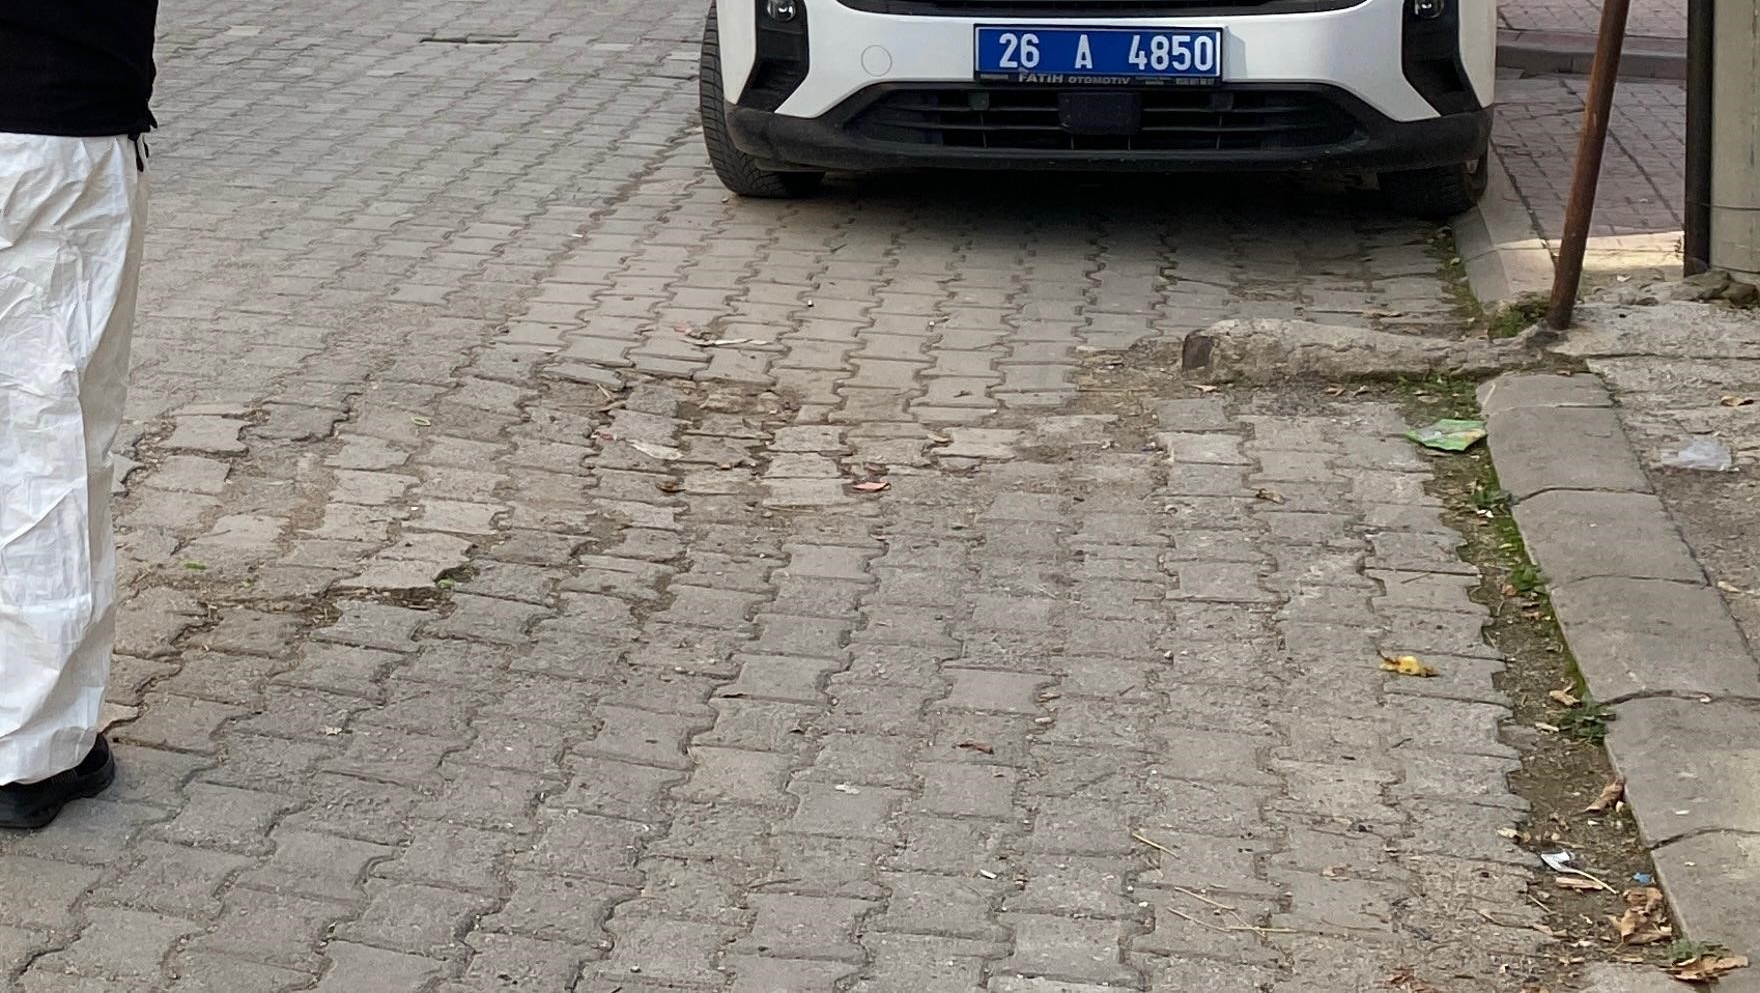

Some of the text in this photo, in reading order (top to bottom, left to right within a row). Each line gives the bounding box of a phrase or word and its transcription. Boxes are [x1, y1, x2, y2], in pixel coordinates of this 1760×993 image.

[999, 32, 1214, 72] 26 A 4850
